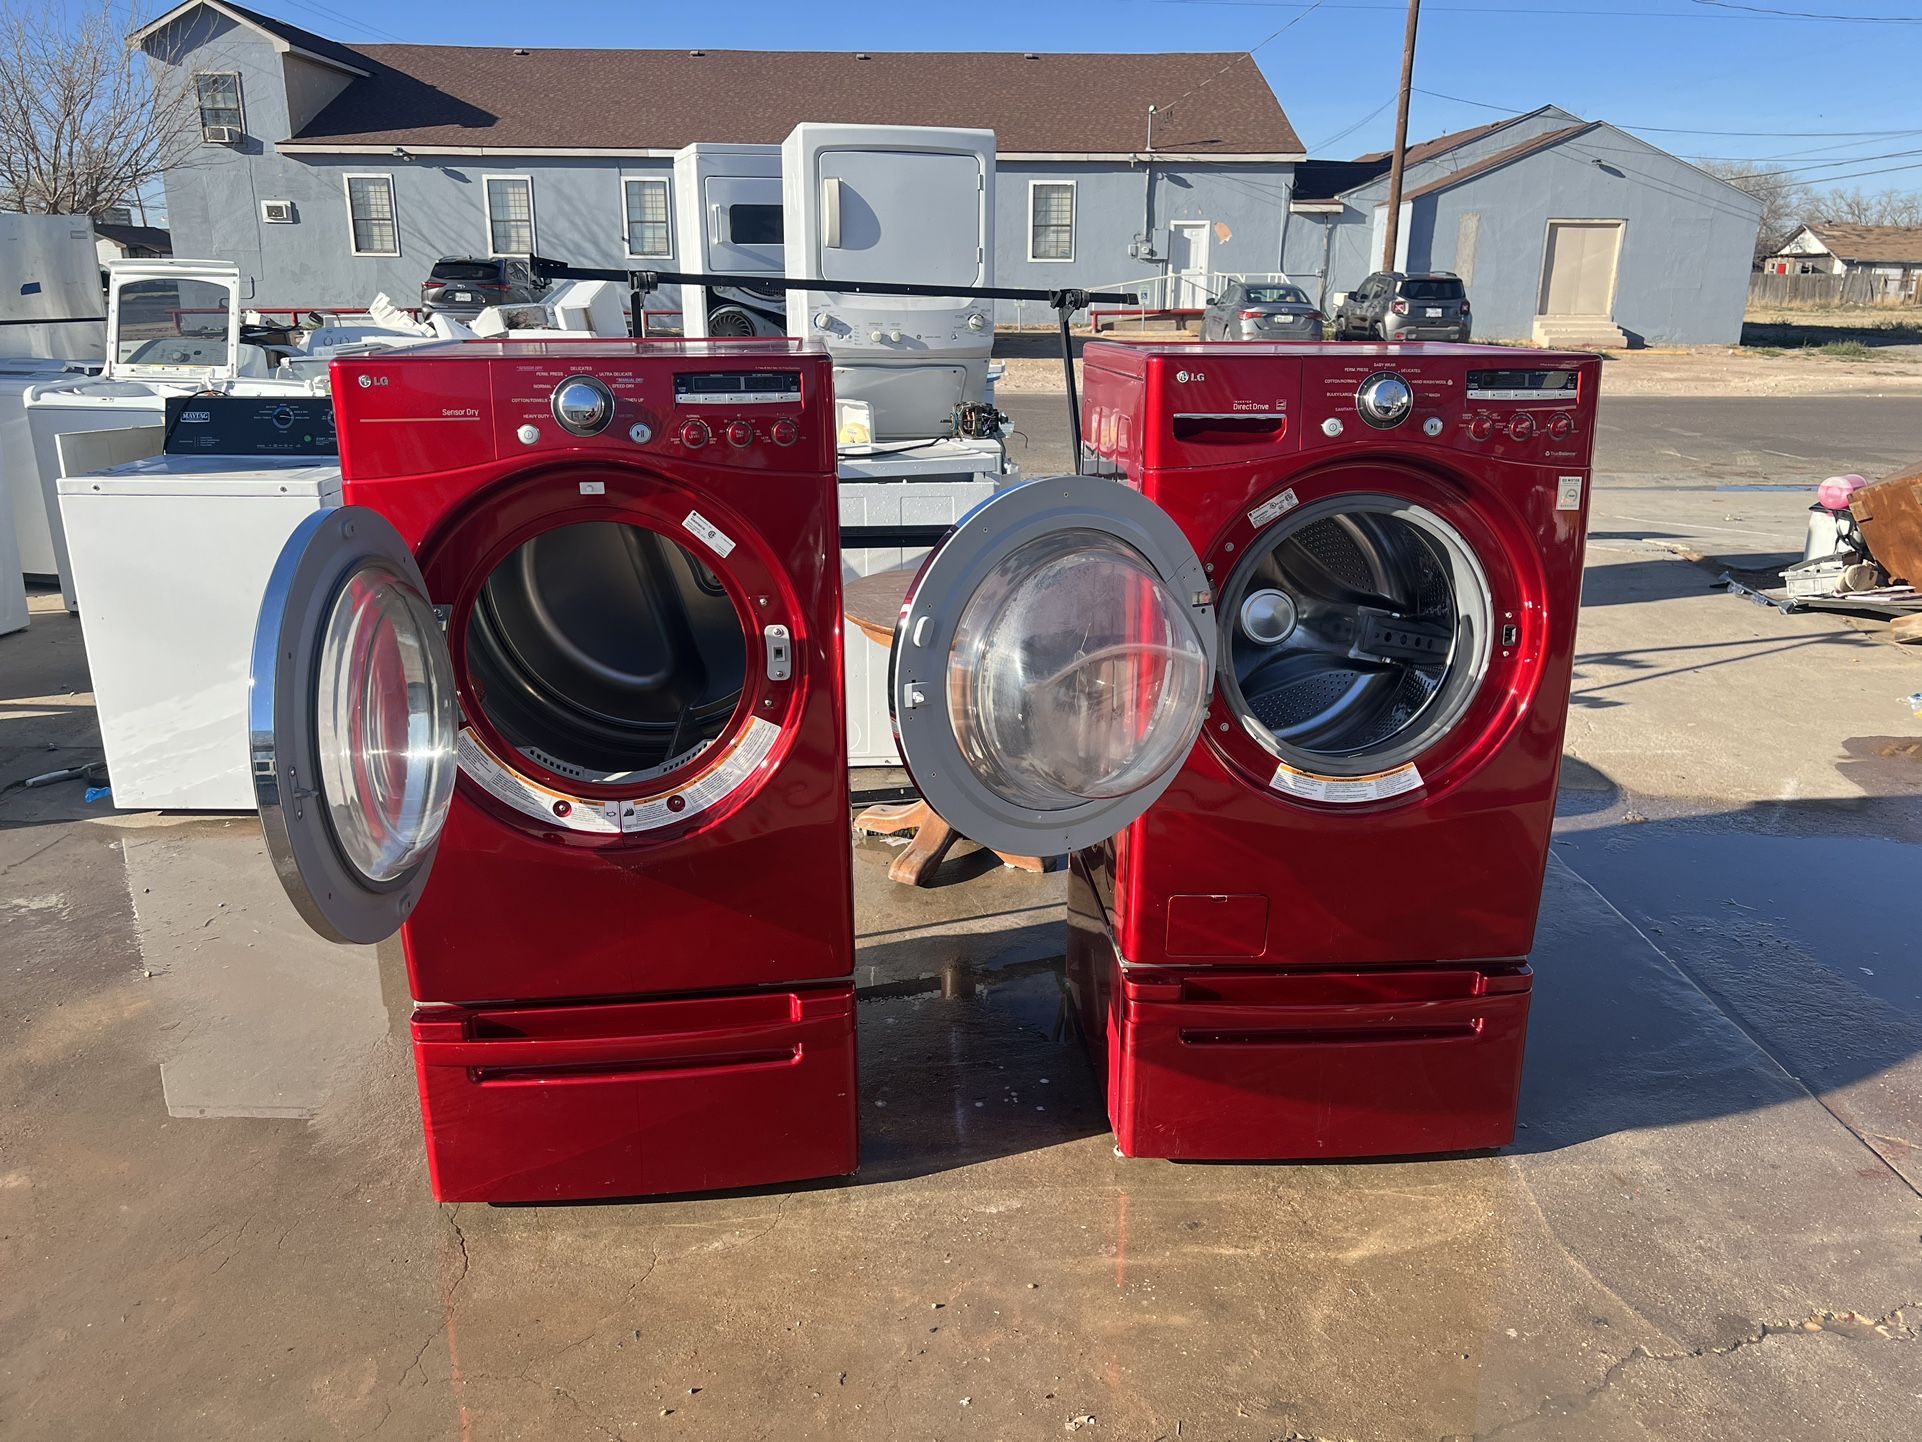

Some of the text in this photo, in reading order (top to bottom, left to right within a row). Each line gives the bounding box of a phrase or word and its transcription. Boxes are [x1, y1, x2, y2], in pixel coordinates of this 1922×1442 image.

[373, 376, 389, 386] LG
[1190, 372, 1205, 382] LG
[442, 408, 479, 417] Sensor Dry
